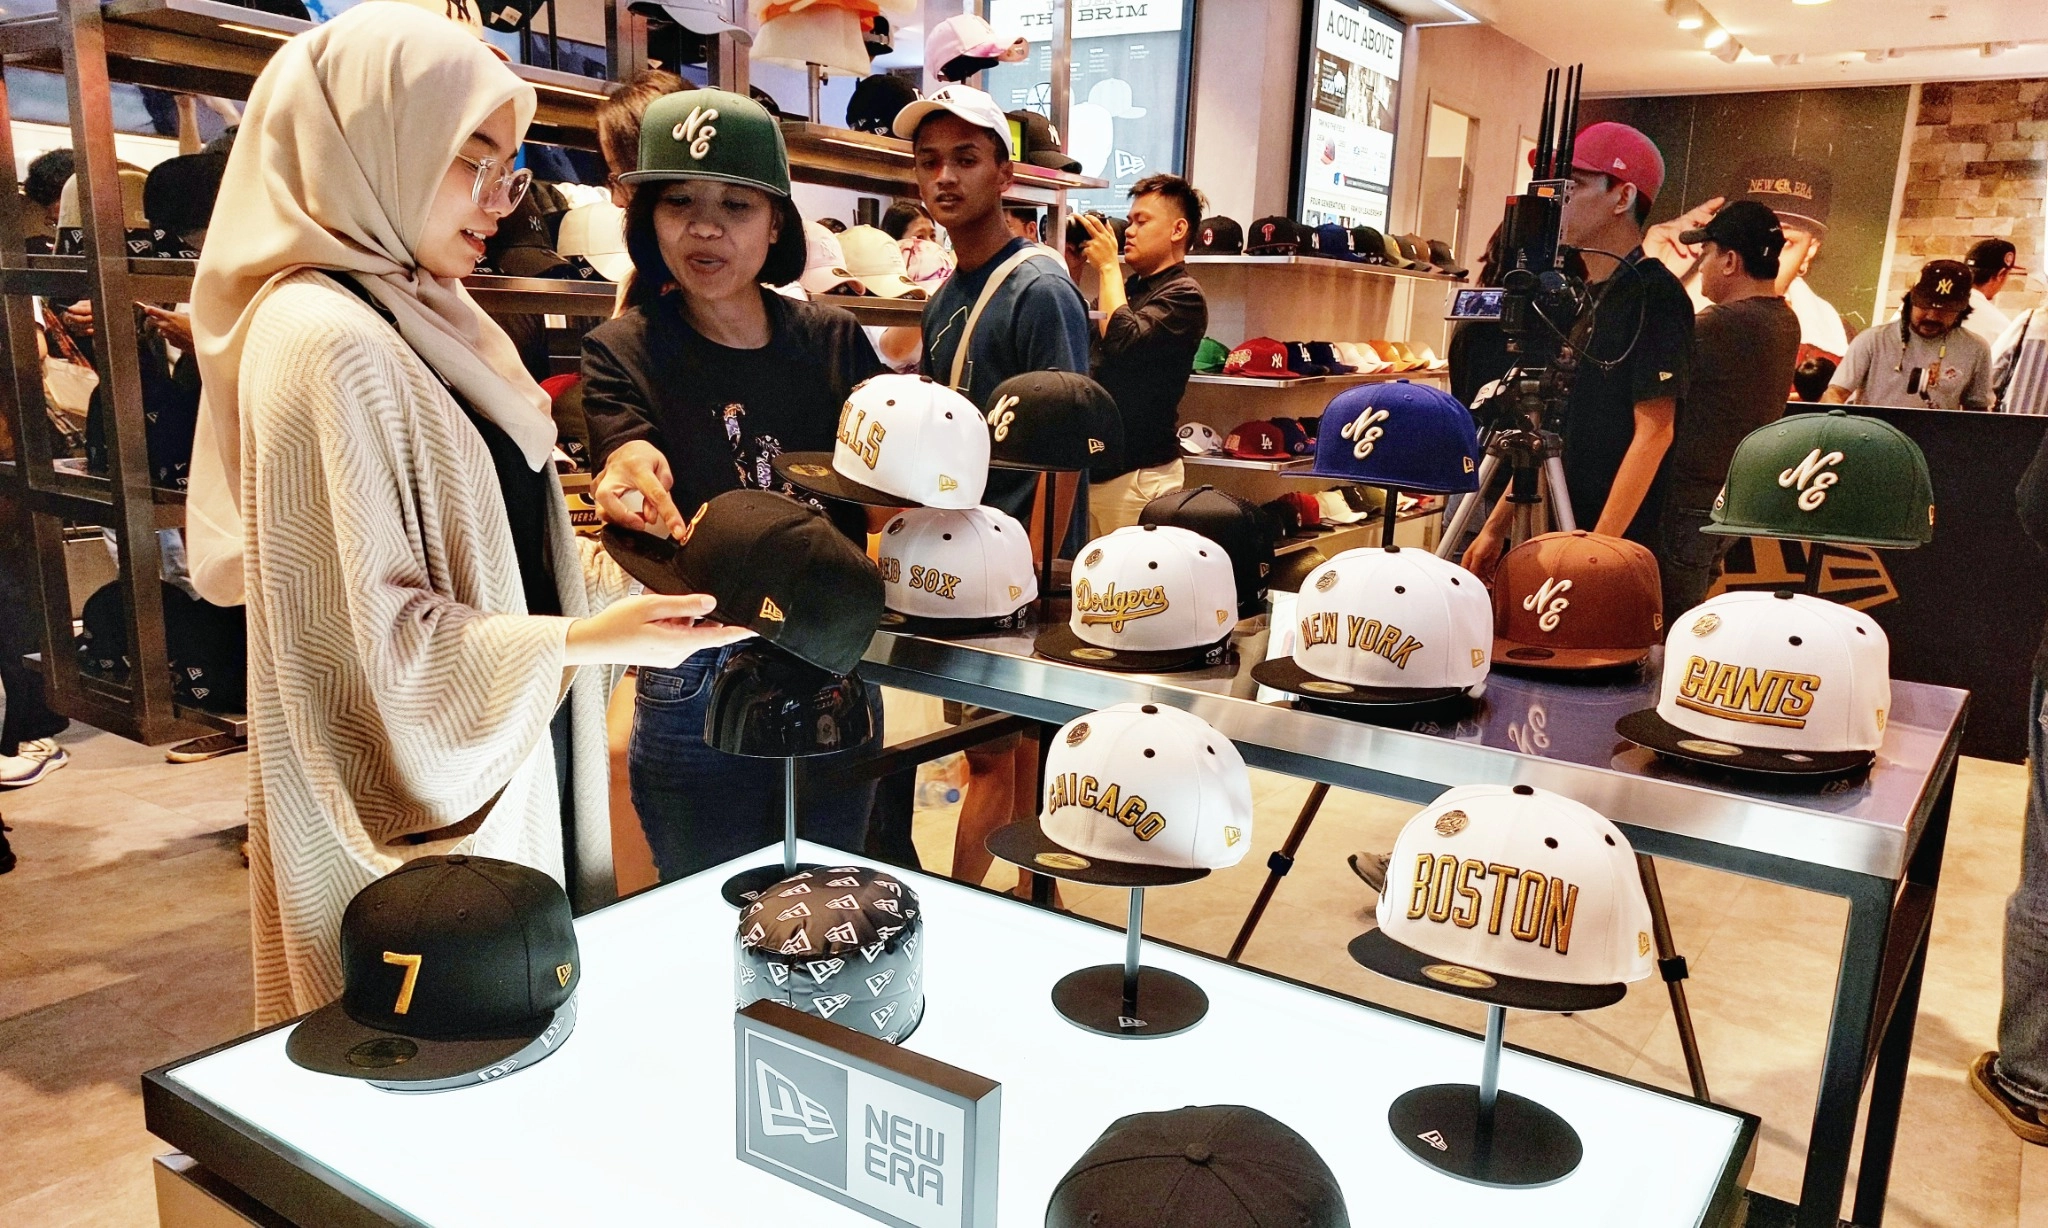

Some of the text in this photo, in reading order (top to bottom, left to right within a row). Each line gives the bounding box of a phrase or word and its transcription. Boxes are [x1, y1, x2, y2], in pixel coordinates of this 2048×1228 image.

[1020, 13, 1053, 26] TH
[1078, 4, 1148, 21] BRIM
[1327, 10, 1394, 59] A CUT ABOVE
[1748, 179, 1812, 199] NEW ERA
[1935, 278, 1954, 295] NY
[1271, 353, 1283, 369] NY
[1297, 343, 1312, 362] LA
[1261, 434, 1273, 450] LA
[909, 565, 961, 600] SOX
[1076, 578, 1168, 634] Dodgers
[1301, 612, 1423, 670] NEW YORK
[1679, 655, 1821, 717] GIANTS
[1049, 773, 1166, 841] CHICAGO
[1407, 853, 1579, 955] BOSTON
[383, 951, 422, 1015] 7
[865, 1103, 945, 1166] NEW
[865, 1142, 944, 1206] ERA
